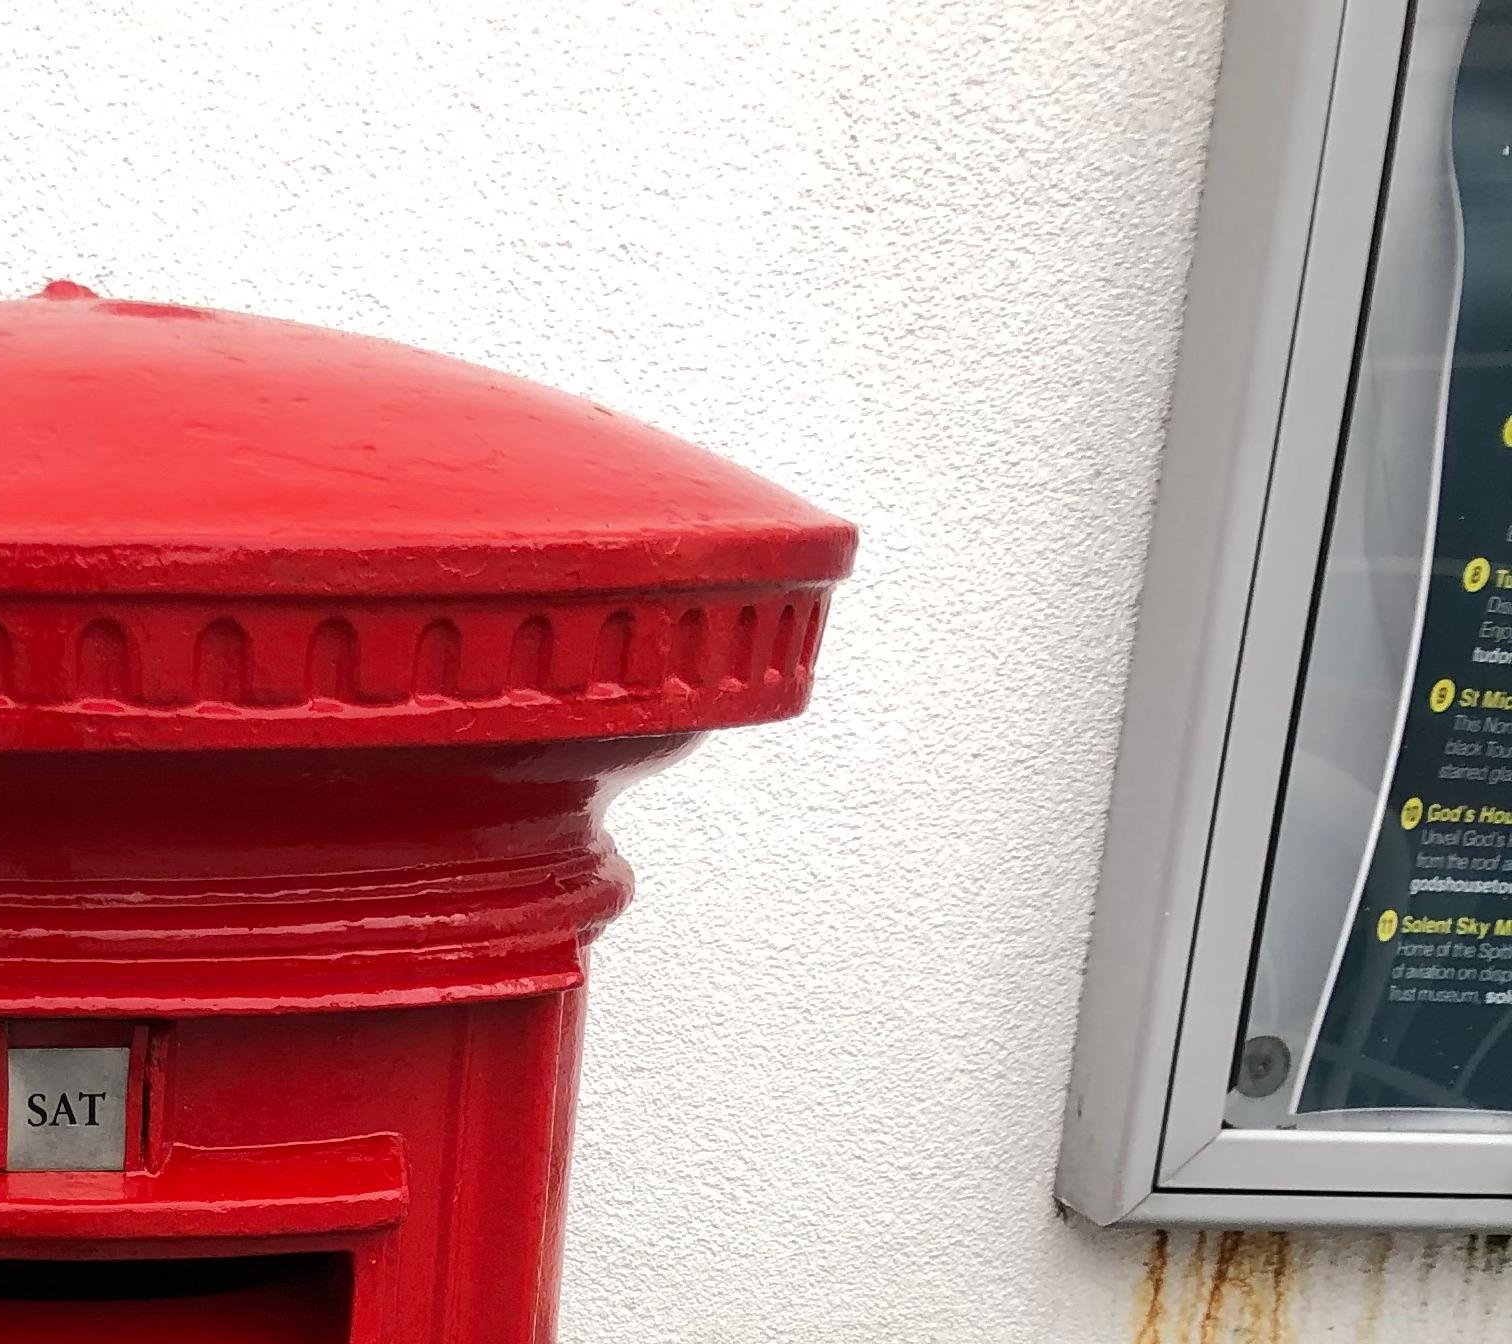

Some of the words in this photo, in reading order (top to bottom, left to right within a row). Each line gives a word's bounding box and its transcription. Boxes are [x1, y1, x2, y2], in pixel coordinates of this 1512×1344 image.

[1427, 803, 1476, 823] God's
[1400, 915, 1452, 935] Solent
[1456, 916, 1491, 940] Sky
[26, 1090, 108, 1128] SAT
